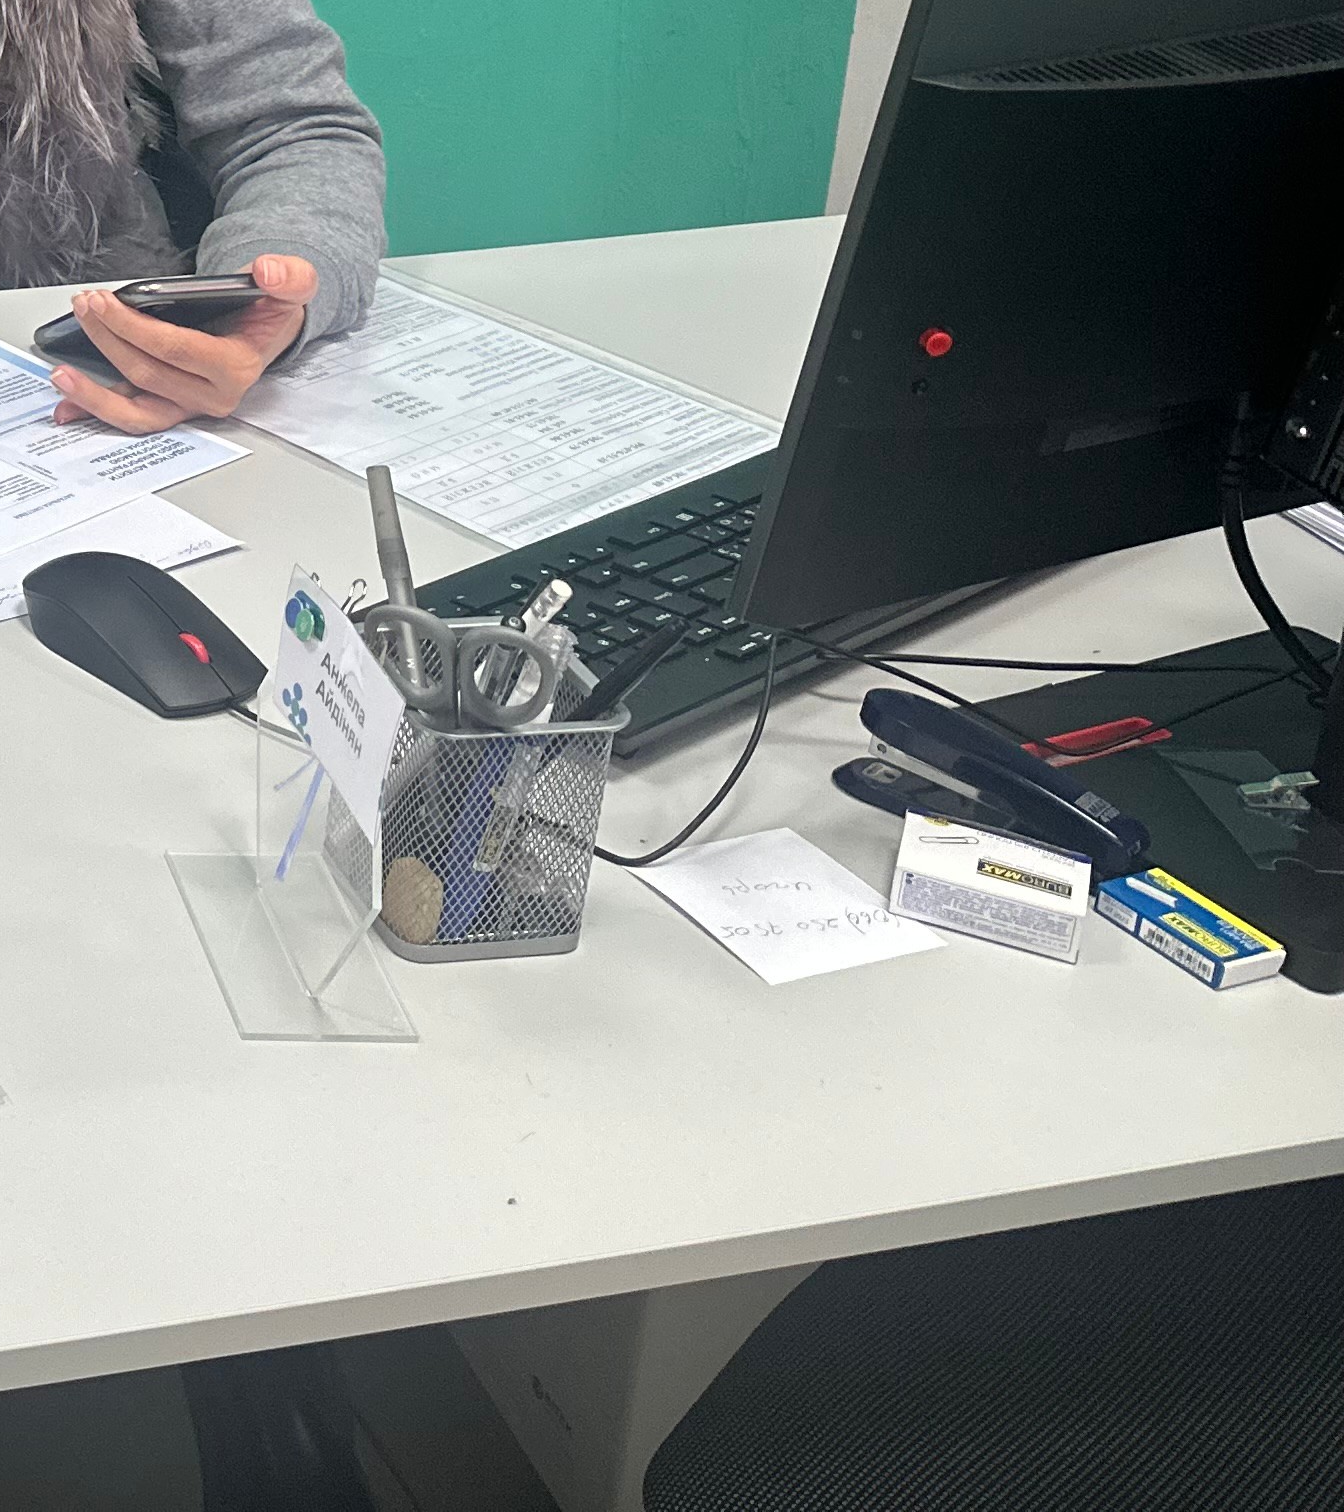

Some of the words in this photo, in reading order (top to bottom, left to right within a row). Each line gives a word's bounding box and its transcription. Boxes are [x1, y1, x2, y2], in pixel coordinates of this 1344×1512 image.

[144, 445, 197, 466] ПОДАТКОВІ
[106, 463, 150, 481] АСПЕКТИ
[320, 650, 365, 729] Анжела
[315, 677, 363, 760] Айдінян
[980, 863, 1070, 895] BUROMAX
